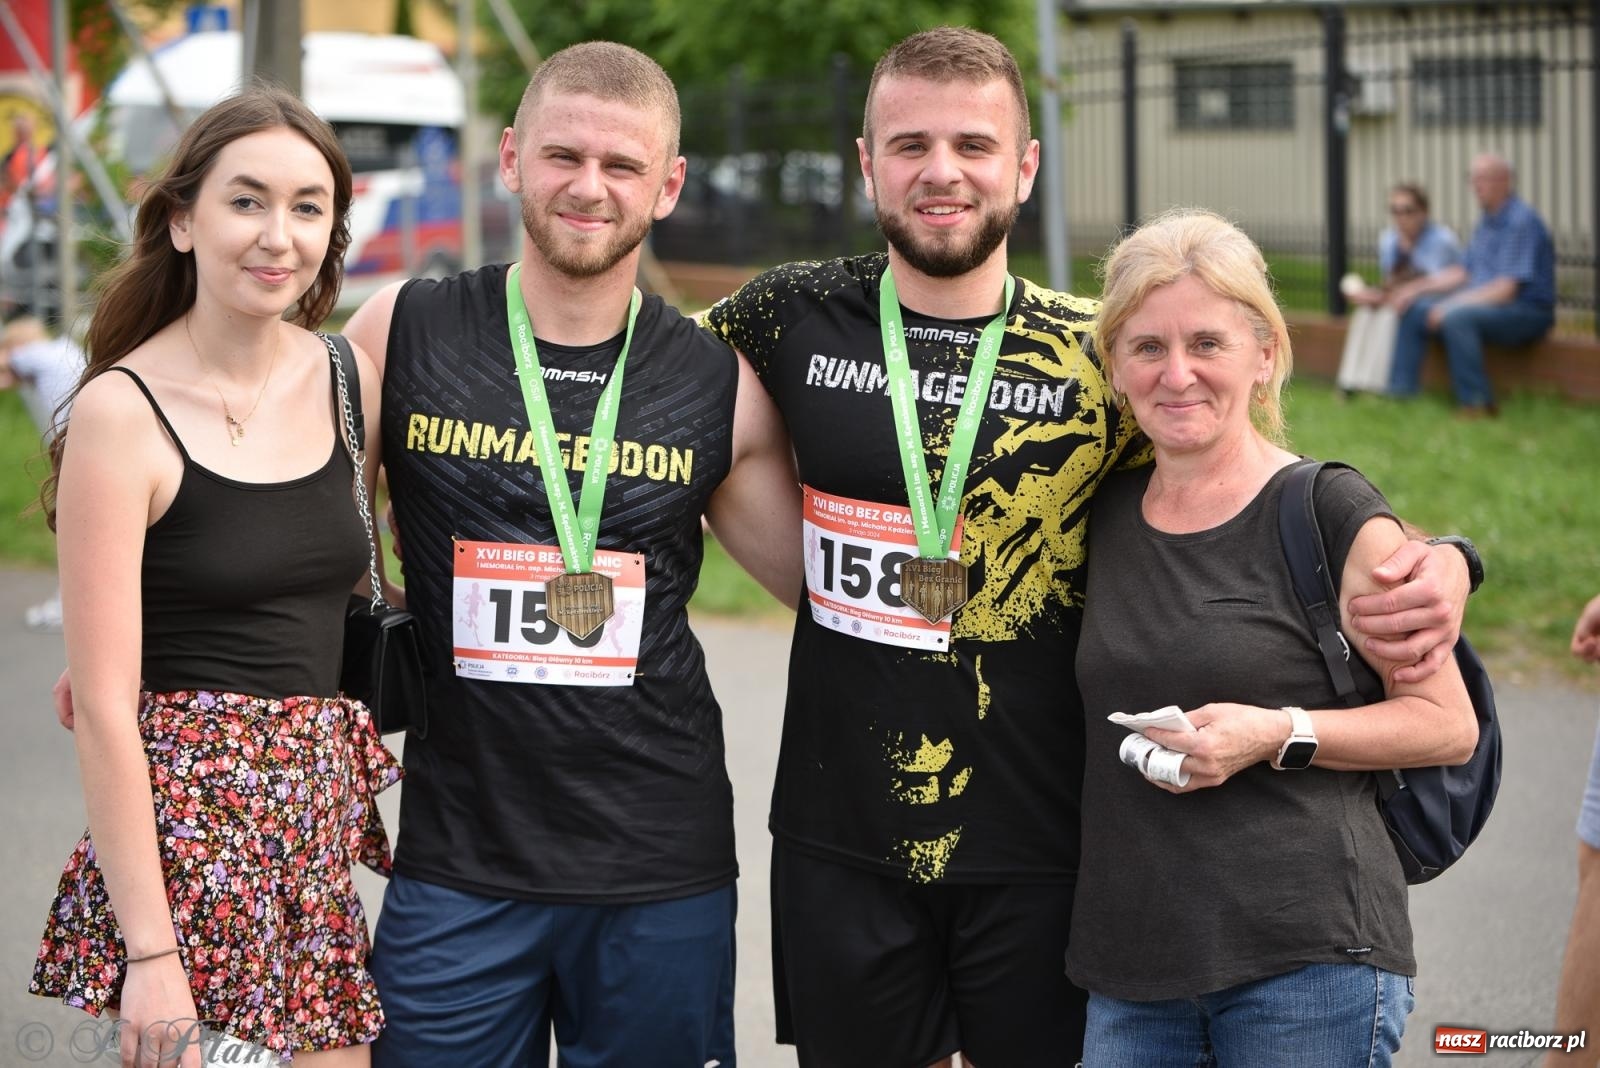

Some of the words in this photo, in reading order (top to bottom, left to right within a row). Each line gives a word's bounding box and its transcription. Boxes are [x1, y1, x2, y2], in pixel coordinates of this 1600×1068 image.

[947, 463, 961, 493] POLICJA
[813, 496, 827, 509] XVI
[828, 501, 854, 516] BIEG
[856, 507, 880, 520] BEZ
[882, 511, 912, 525] GRA
[476, 548, 500, 561] XVI
[503, 549, 535, 563] BIEG
[538, 552, 564, 565] BEZ
[820, 537, 914, 608] 158
[573, 583, 604, 593] POLICJA
[883, 629, 921, 640] Racibórz
[574, 671, 610, 680] Racibórz
